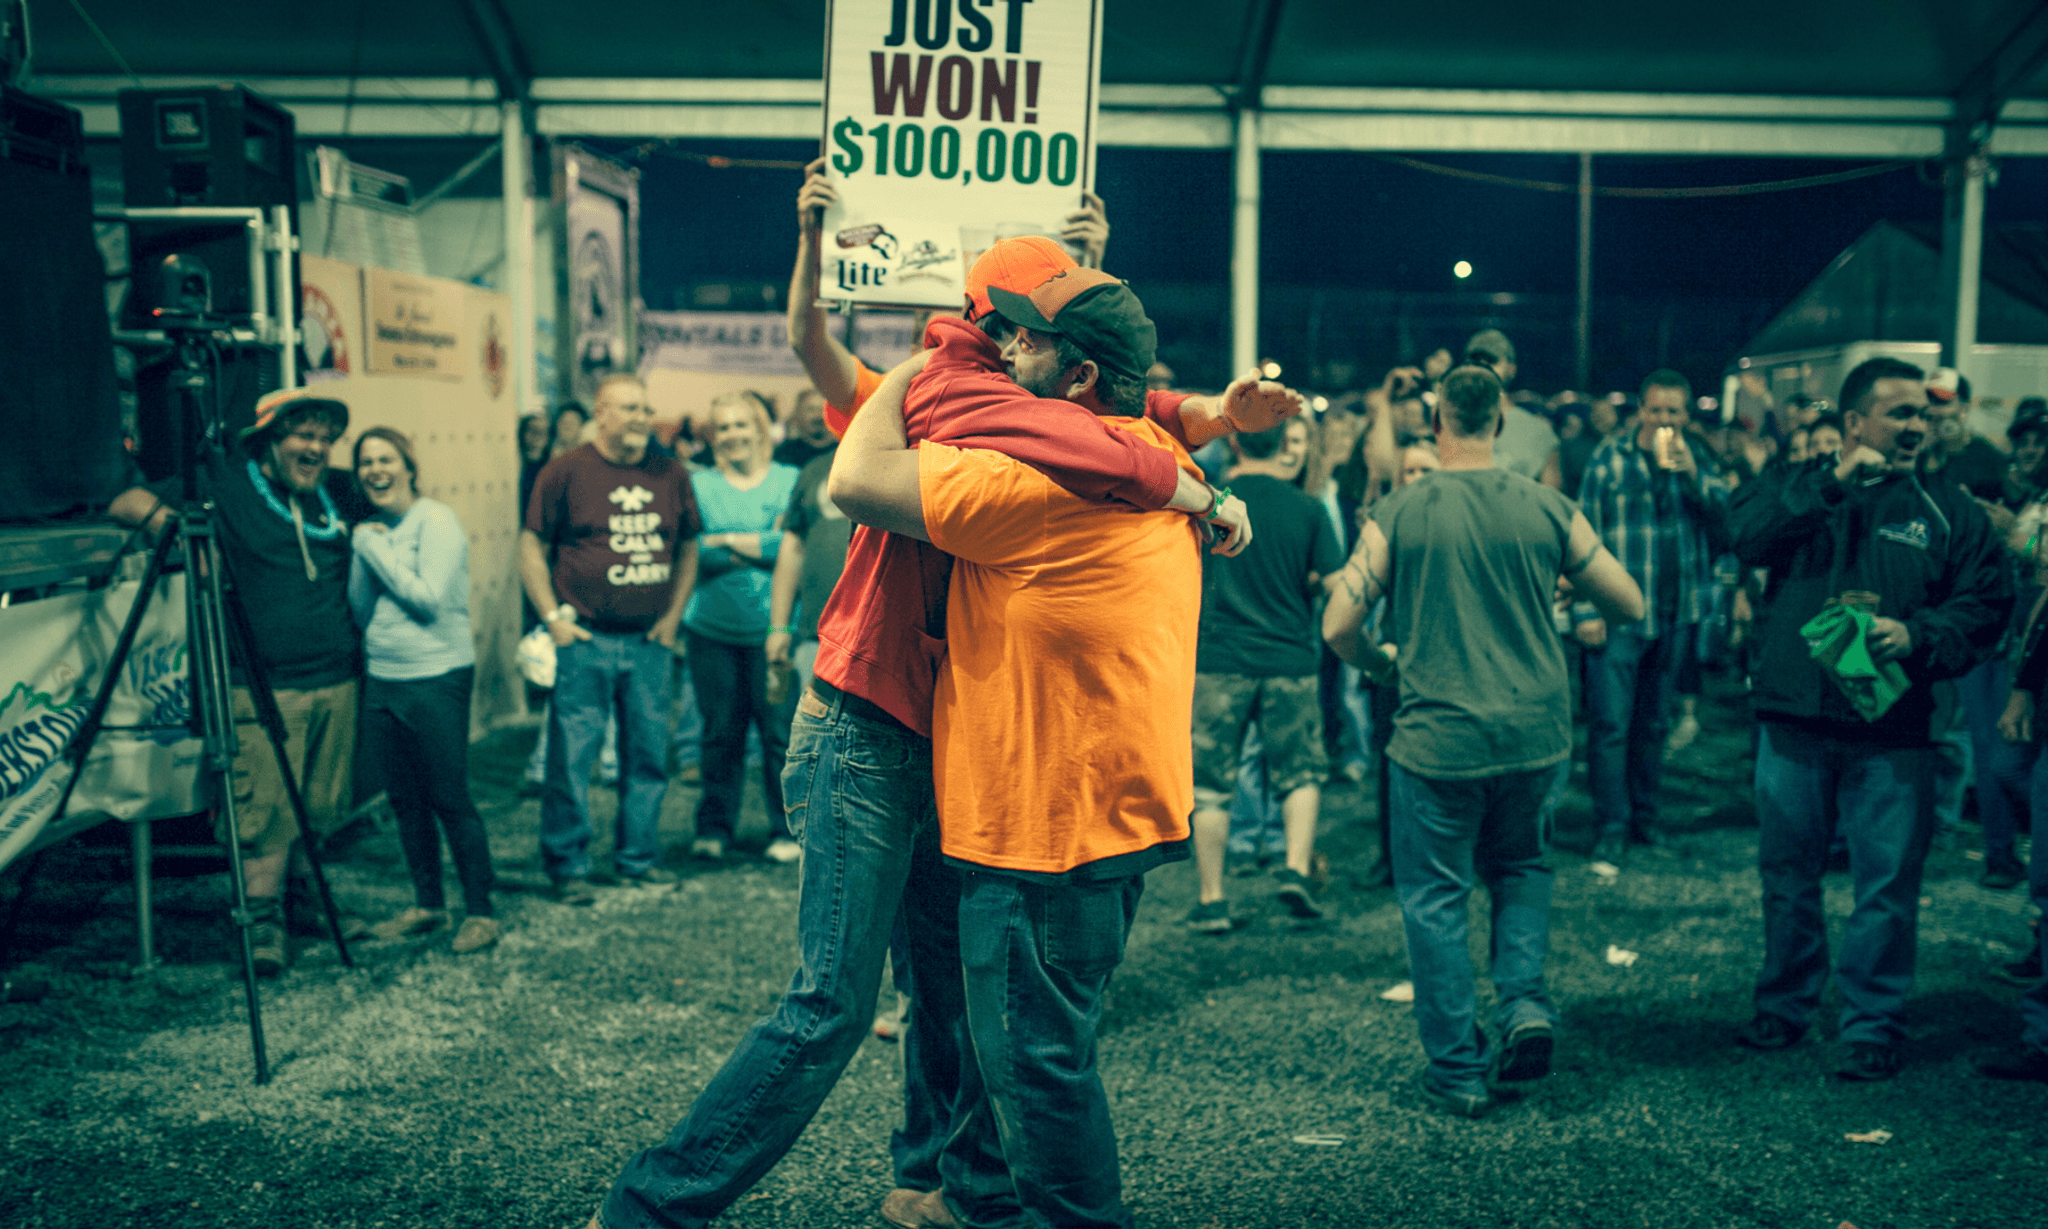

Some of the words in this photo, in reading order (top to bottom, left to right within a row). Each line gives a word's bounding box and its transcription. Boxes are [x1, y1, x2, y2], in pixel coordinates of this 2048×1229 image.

[884, 0, 1034, 53] JUST
[870, 51, 1042, 124] WON!
[832, 116, 1078, 187] $100,000
[838, 260, 887, 291] Lite
[608, 512, 662, 534] KEEP
[609, 533, 665, 553] CALM
[607, 564, 671, 585] CARRY
